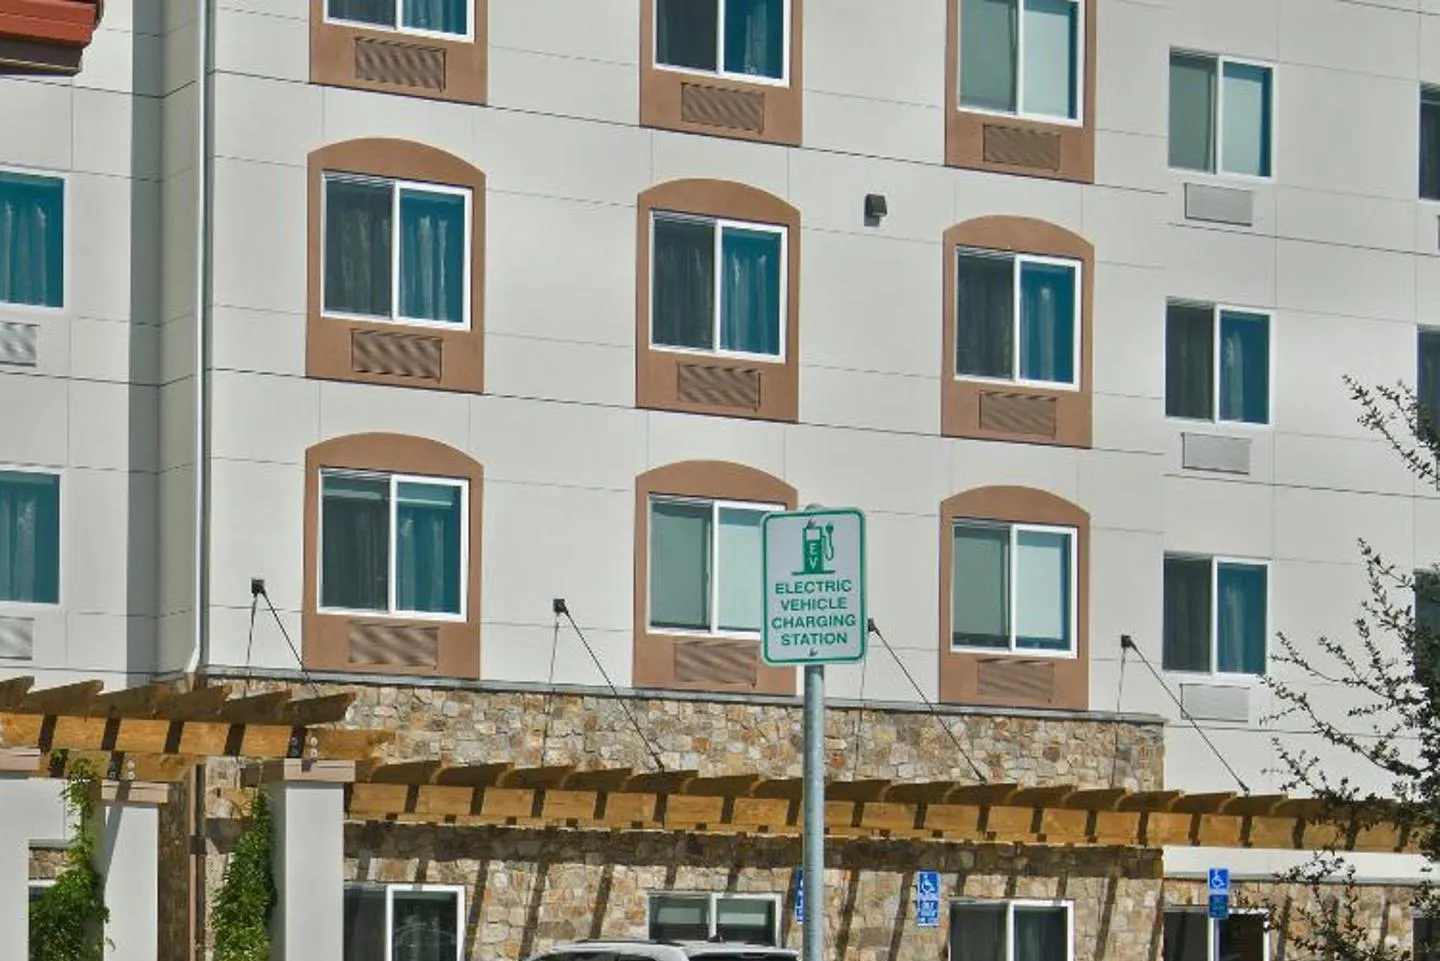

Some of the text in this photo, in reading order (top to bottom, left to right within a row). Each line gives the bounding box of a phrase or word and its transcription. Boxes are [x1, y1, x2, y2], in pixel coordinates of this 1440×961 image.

[775, 579, 852, 594] ELECTRIC
[780, 597, 847, 611] VEHICLE
[771, 614, 856, 629] CHARGING
[781, 632, 848, 646] STATION
